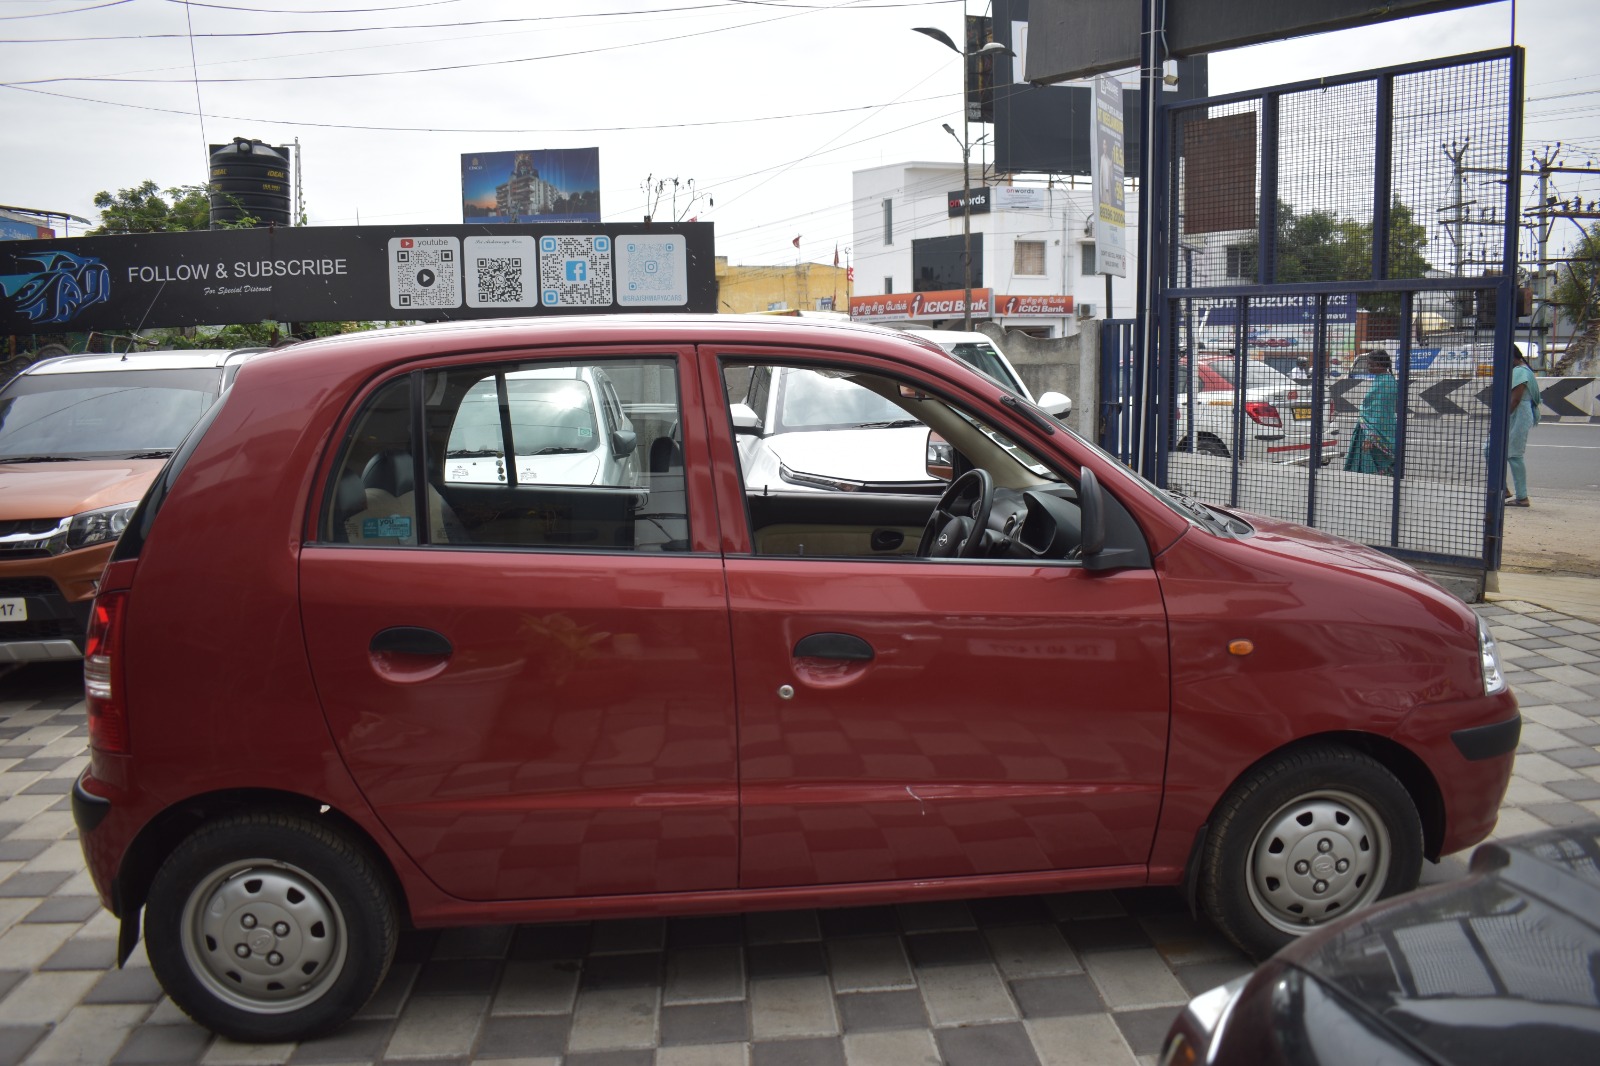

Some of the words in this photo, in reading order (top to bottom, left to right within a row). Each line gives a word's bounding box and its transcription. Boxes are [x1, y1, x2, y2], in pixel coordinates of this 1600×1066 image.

[949, 195, 985, 207] onwrds
[417, 238, 449, 248] youtube
[127, 263, 210, 283] FOLLOW
[215, 262, 229, 279] &
[233, 259, 348, 278] SUBSCRIBE
[203, 286, 216, 296] For
[217, 286, 243, 296] Special
[243, 284, 273, 293] Discount
[923, 300, 954, 313] ICICI
[954, 298, 988, 311] Bnk
[1306, 294, 1348, 306] SVICE
[1018, 305, 1041, 313] ICICI
[1041, 305, 1065, 313] Bank
